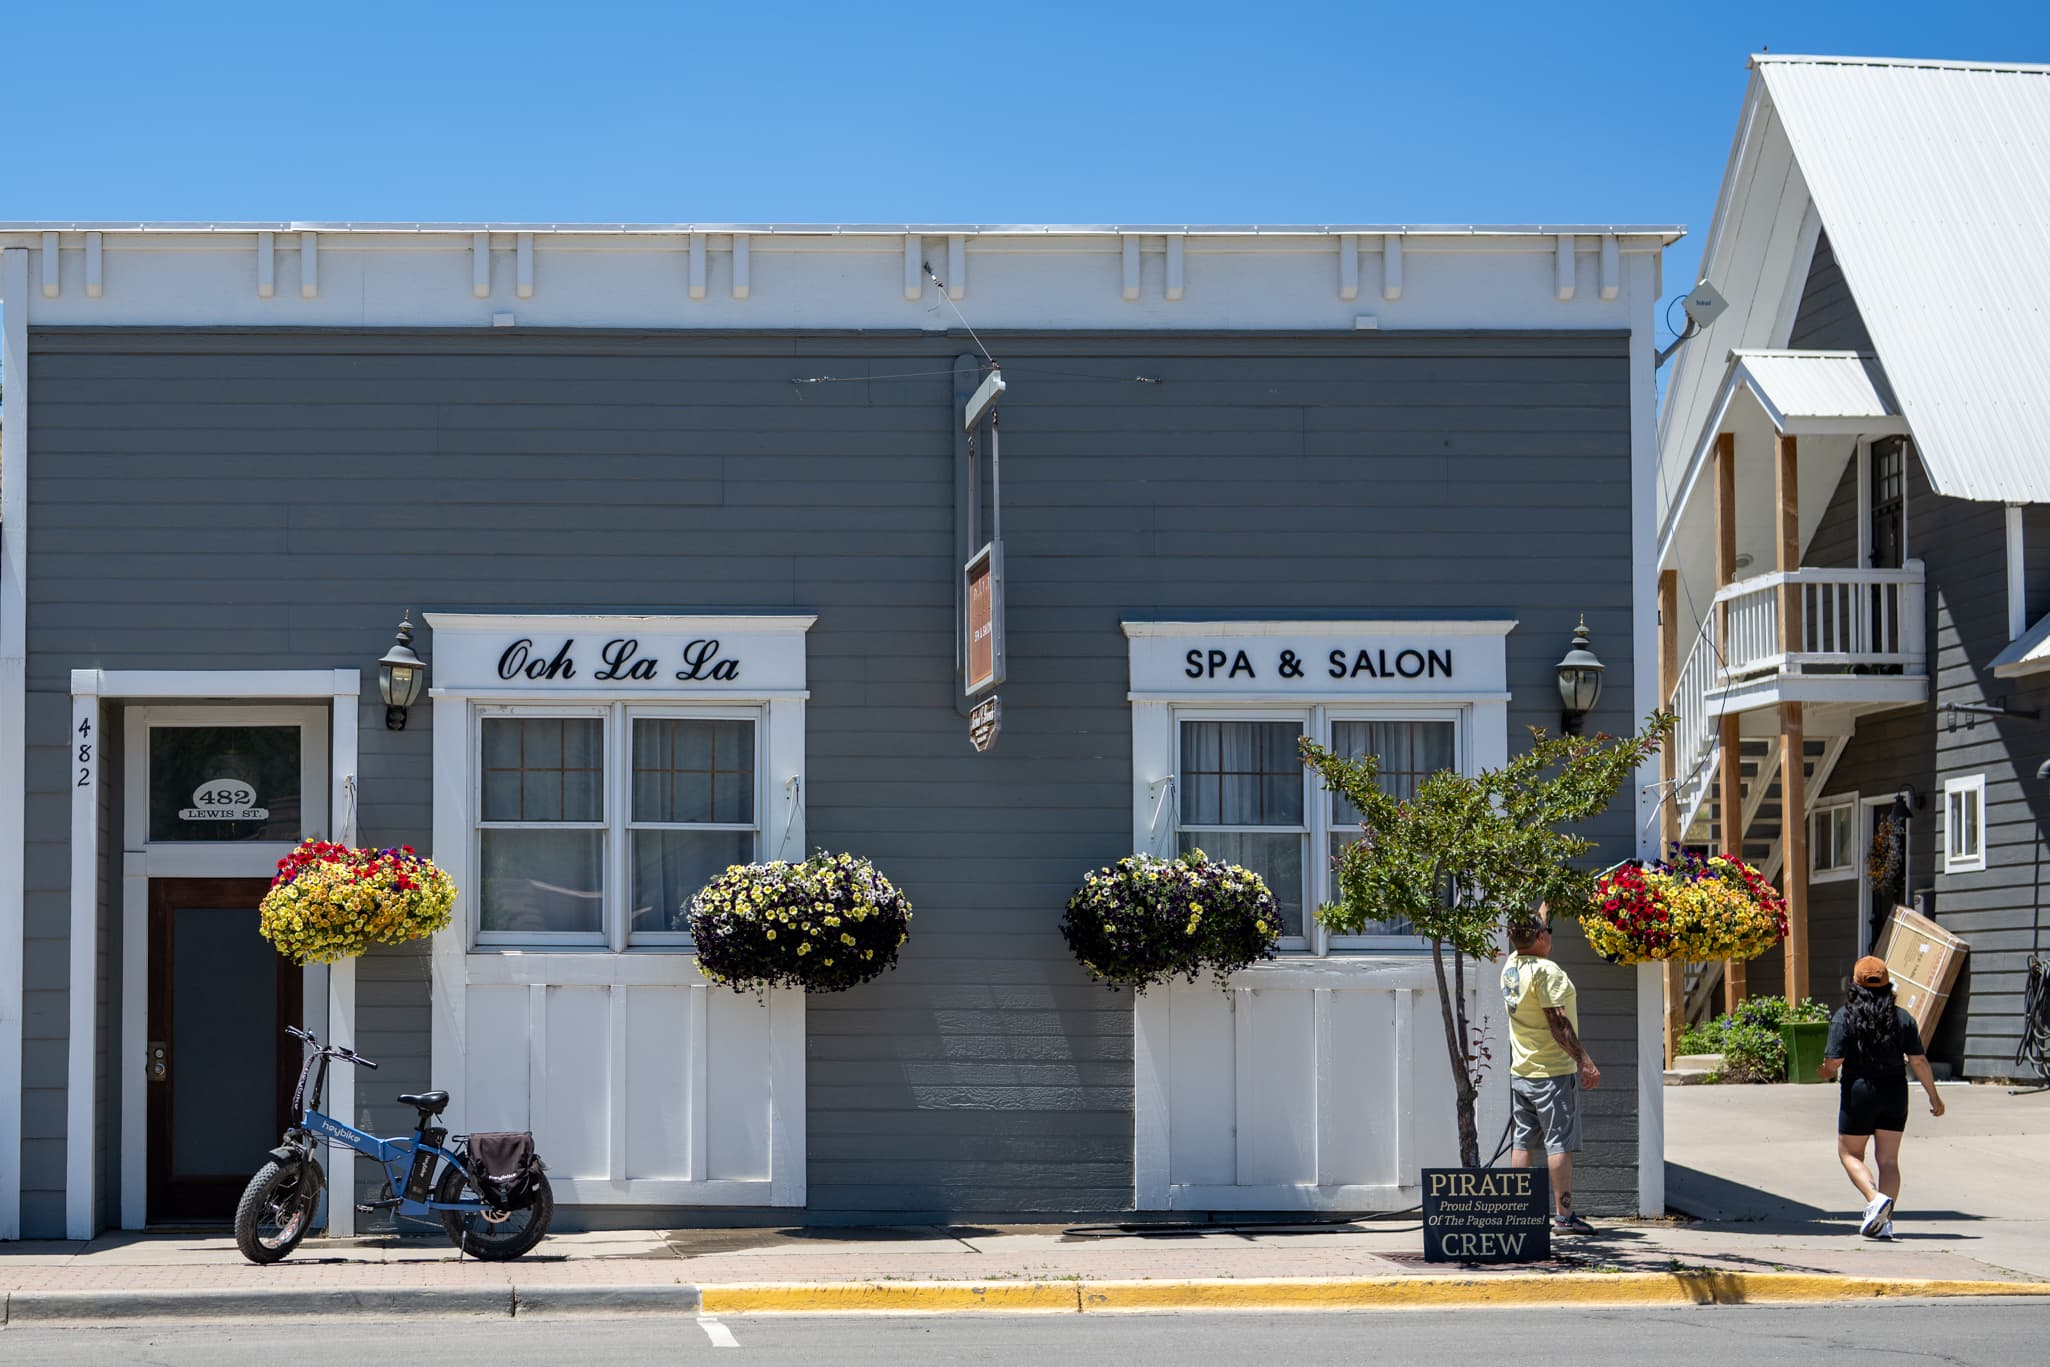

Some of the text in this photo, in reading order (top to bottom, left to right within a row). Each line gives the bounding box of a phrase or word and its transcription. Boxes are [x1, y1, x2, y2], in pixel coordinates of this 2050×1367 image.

[498, 639, 740, 680] Ooh La La
[1185, 649, 1453, 679] SPA & SALON
[77, 717, 92, 787] 482
[199, 790, 251, 805] 482
[187, 809, 263, 818] LEWIS ST.
[321, 1120, 361, 1143] heybike
[1430, 1173, 1532, 1196] PIRATE
[1440, 1200, 1529, 1213] Proud Supporter
[1428, 1215, 1546, 1228] Of The Pagosa Pirates!
[1441, 1233, 1527, 1256] CREW
